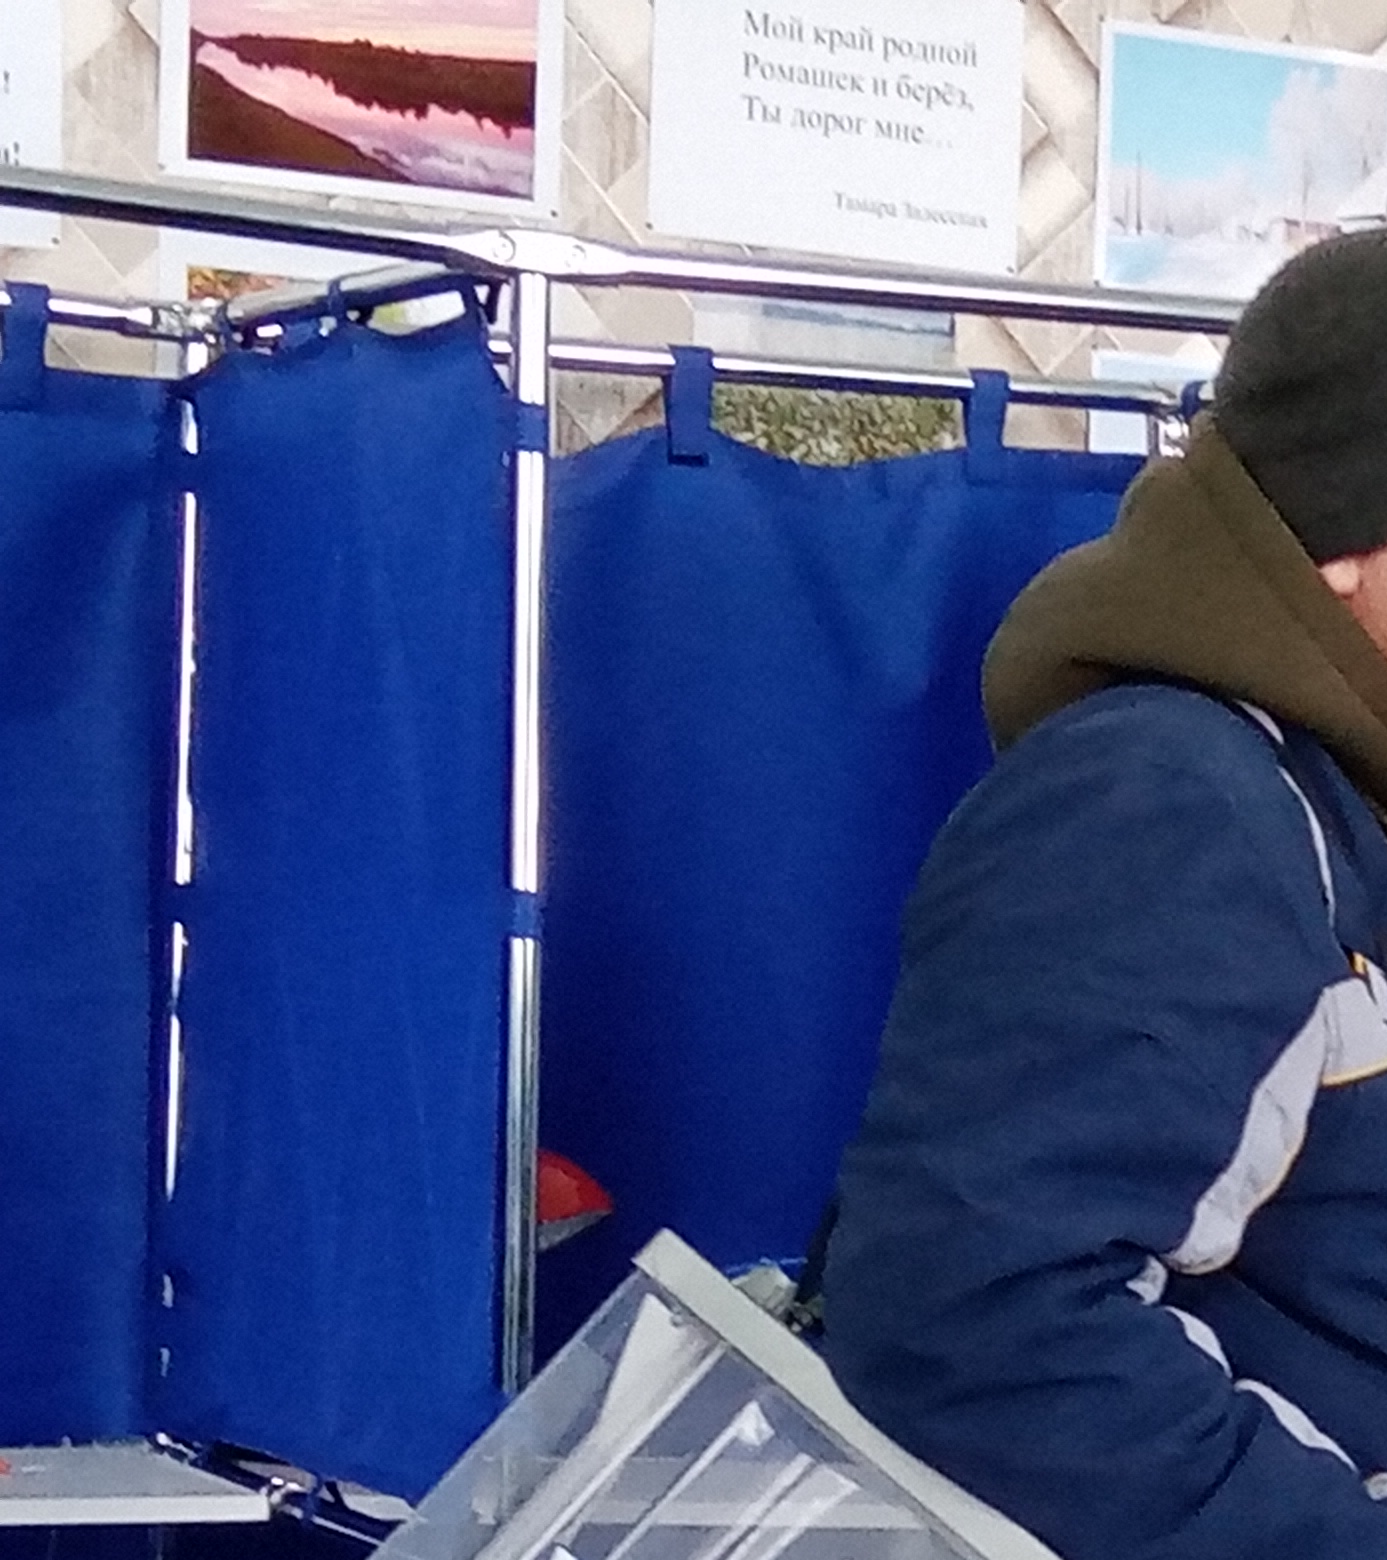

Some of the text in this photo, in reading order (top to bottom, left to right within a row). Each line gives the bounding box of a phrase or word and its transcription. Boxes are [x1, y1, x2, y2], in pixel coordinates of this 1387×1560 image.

[744, 9, 978, 68] Мой край родной
[742, 51, 975, 111] Ромашек и берёз,
[740, 93, 782, 124] Ты
[790, 107, 868, 139] дорог
